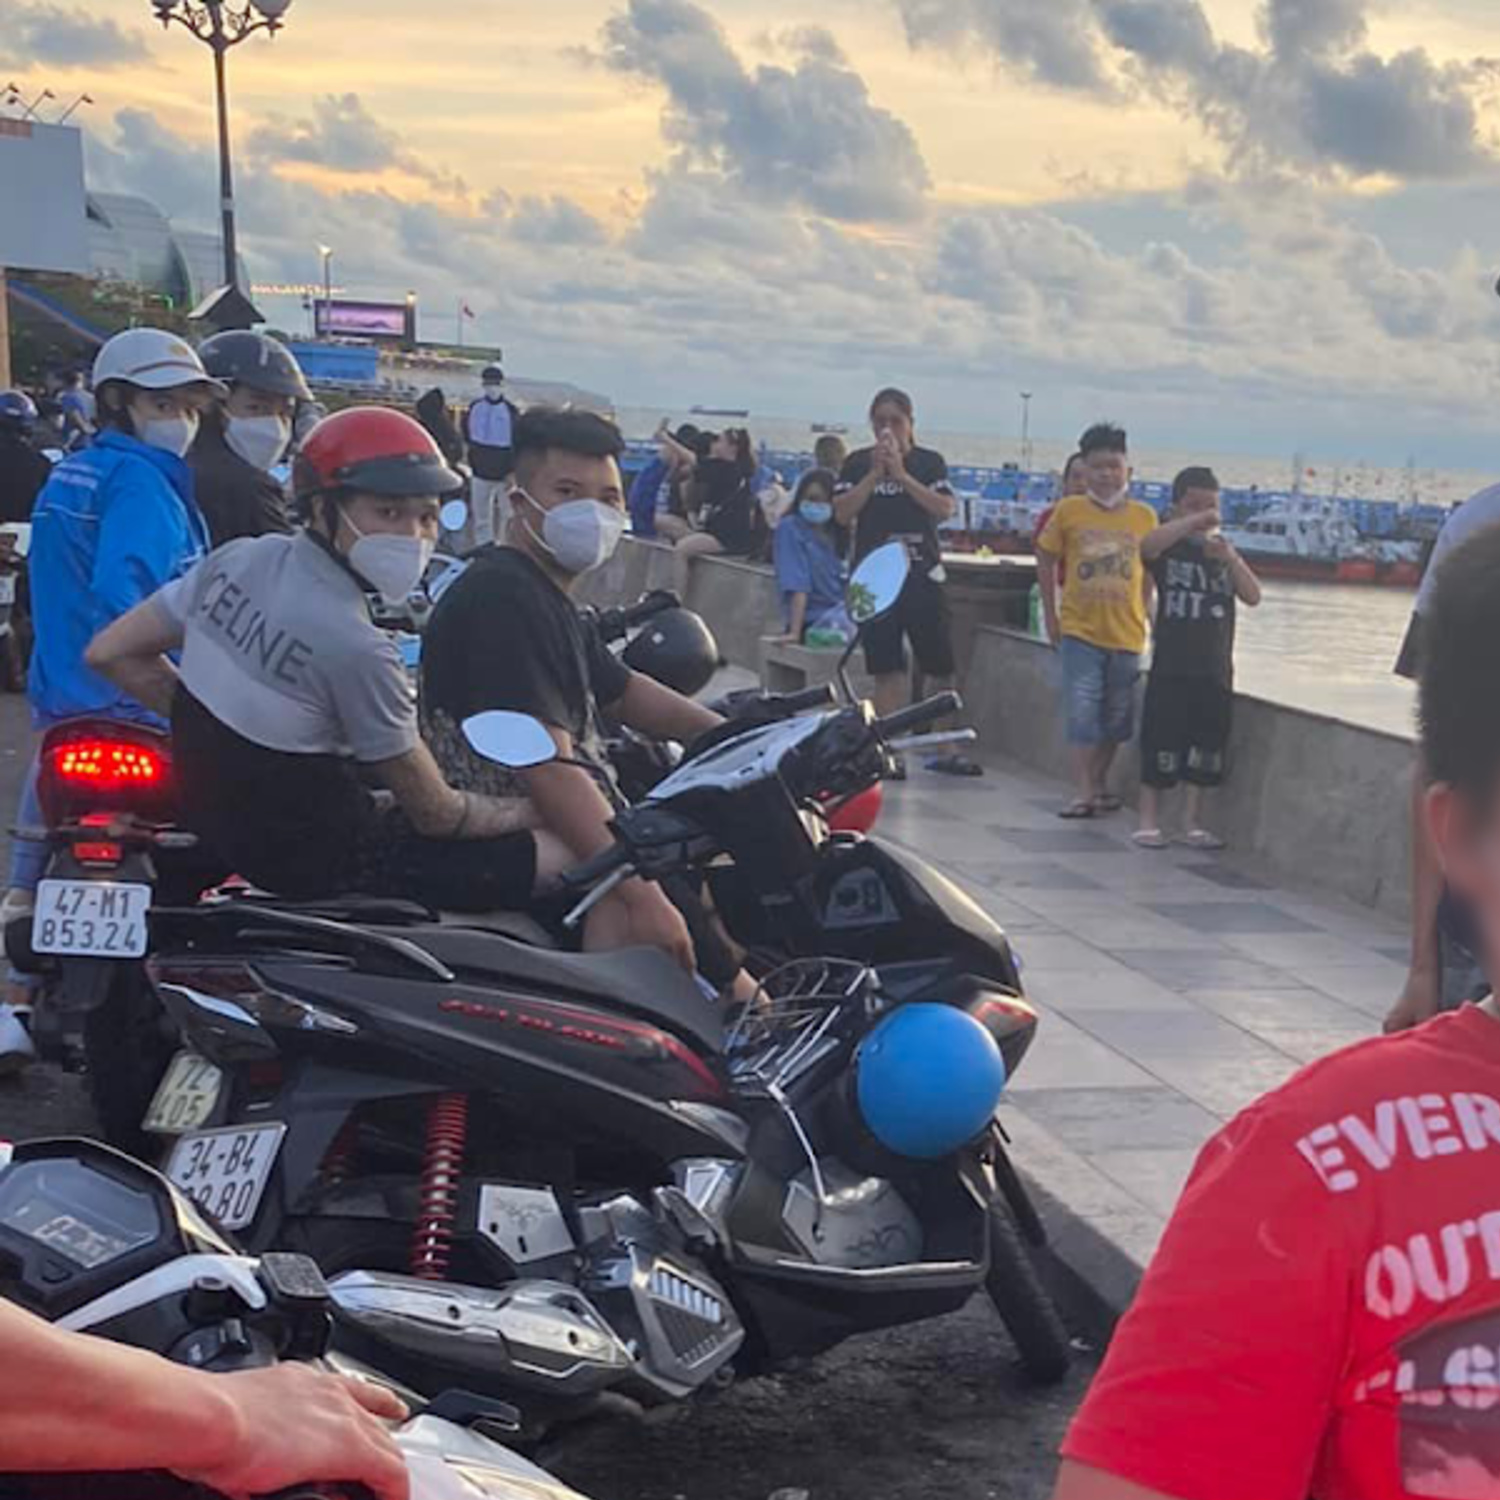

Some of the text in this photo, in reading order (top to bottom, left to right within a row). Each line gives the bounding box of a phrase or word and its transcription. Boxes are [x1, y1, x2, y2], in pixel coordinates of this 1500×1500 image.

[201, 572, 314, 684] CELINE
[54, 887, 130, 919] 47-M1
[41, 919, 137, 952] 853.24
[182, 1132, 260, 1181] 34-B4
